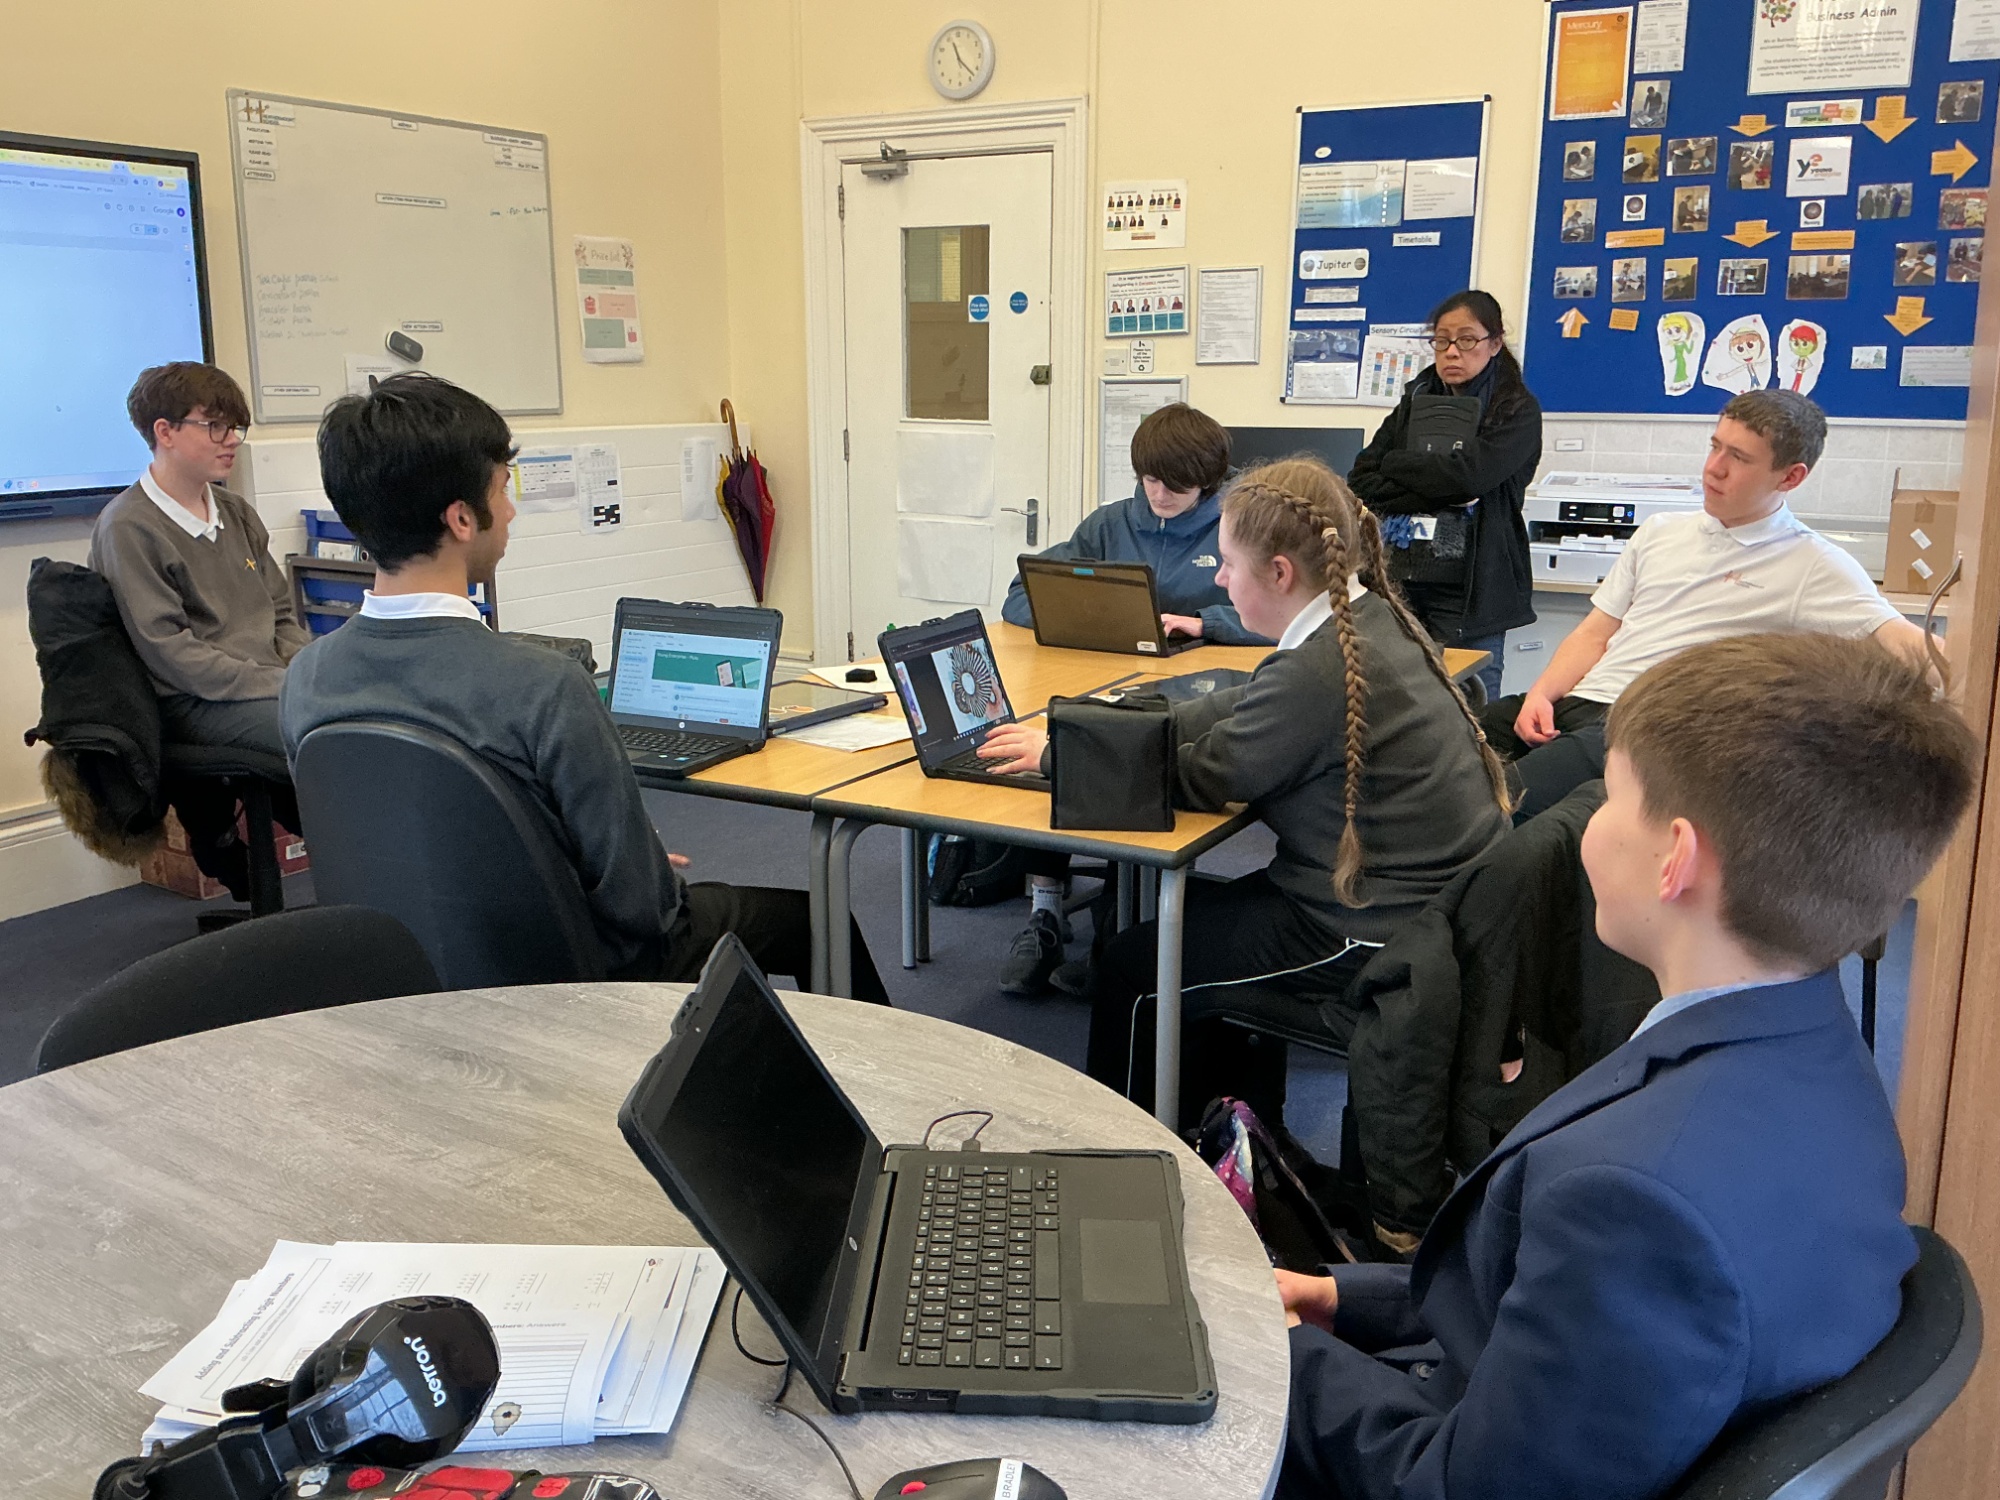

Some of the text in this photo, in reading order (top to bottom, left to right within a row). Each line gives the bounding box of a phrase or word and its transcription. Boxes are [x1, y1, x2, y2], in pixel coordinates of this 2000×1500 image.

[1806, 6, 1897, 22] Business Admin
[1566, 20, 1602, 30] Mercury
[153, 206, 174, 215] Google
[591, 250, 608, 260] Price
[1316, 260, 1351, 271] Jupiter
[1371, 326, 1398, 334] Sensory
[194, 1358, 222, 1380] Adding
[216, 1347, 230, 1360] and
[224, 1315, 261, 1348] Subtracting
[253, 1297, 275, 1315] 4-Digit
[270, 1272, 294, 1296] Numbers
